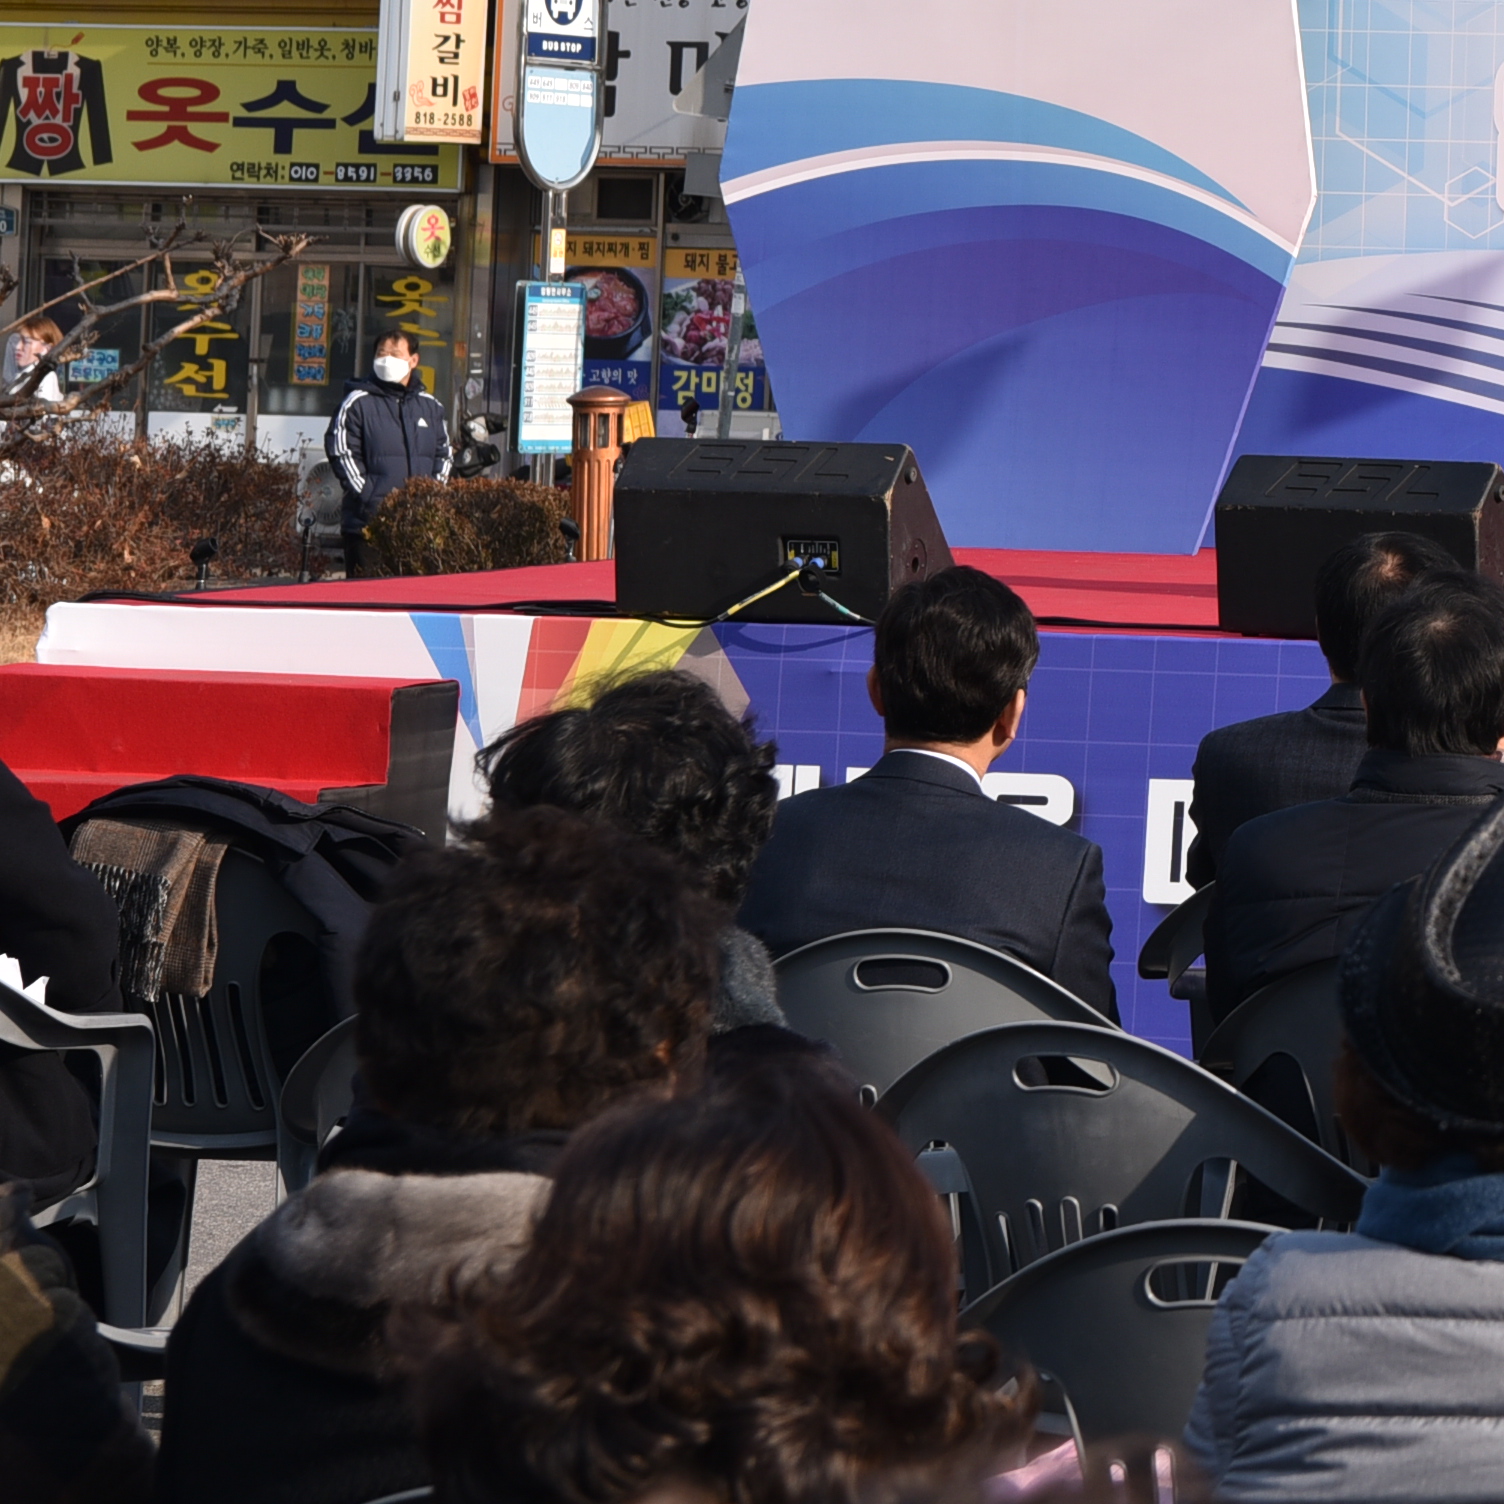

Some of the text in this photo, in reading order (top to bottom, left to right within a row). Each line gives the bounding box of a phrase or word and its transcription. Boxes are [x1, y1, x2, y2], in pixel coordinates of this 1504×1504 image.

[340, 39, 377, 61] 청바
[541, 39, 583, 54] BUS STOP
[17, 72, 81, 159] 짱
[414, 111, 474, 127] 818-2588
[229, 161, 287, 182] 연락처:
[421, 213, 446, 243] 옷
[683, 252, 710, 269] 돼지
